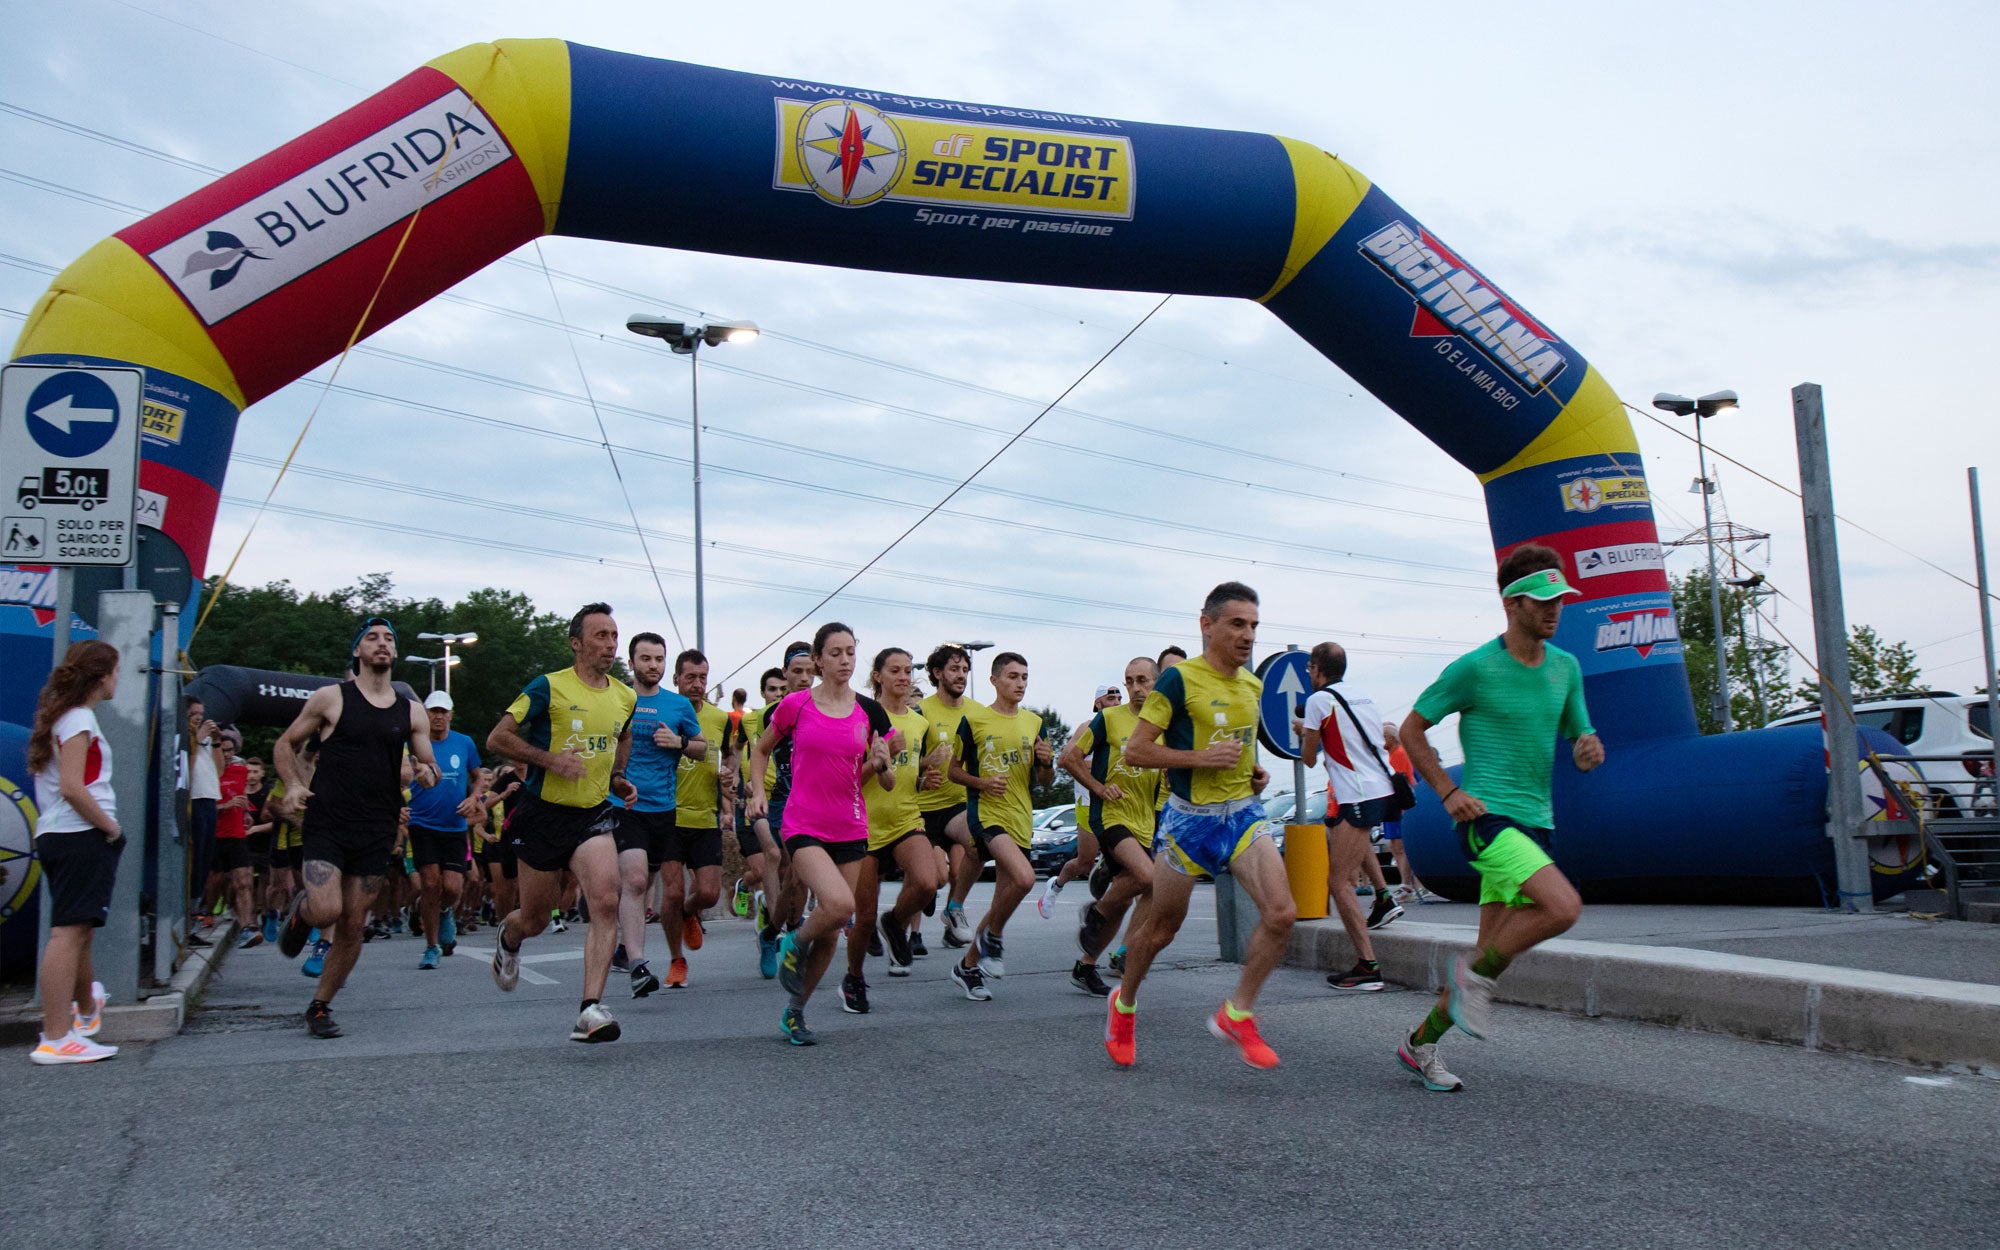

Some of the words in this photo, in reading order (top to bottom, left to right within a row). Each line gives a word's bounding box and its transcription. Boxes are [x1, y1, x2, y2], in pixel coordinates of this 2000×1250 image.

[771, 80, 1122, 128] www.df-sportspecialist.it
[422, 144, 500, 194] FASHION
[982, 136, 1118, 171] SPORT
[254, 111, 486, 248] BLUFRIDA
[911, 160, 1118, 200] SPECIALIST
[914, 208, 982, 226] Sport
[981, 217, 1020, 231] per
[1021, 221, 1114, 237] passione
[1433, 338, 1453, 355] IO
[1446, 349, 1463, 363] E
[1455, 357, 1477, 376] LA
[1470, 369, 1497, 393] MIA
[1491, 386, 1520, 411] BICI
[55, 470, 98, 497] 5,0t
[56, 532, 110, 545] CARICO
[114, 534, 122, 544] E
[57, 519, 94, 530] SOLO
[99, 520, 125, 531] PER
[58, 547, 120, 558] SCARICO
